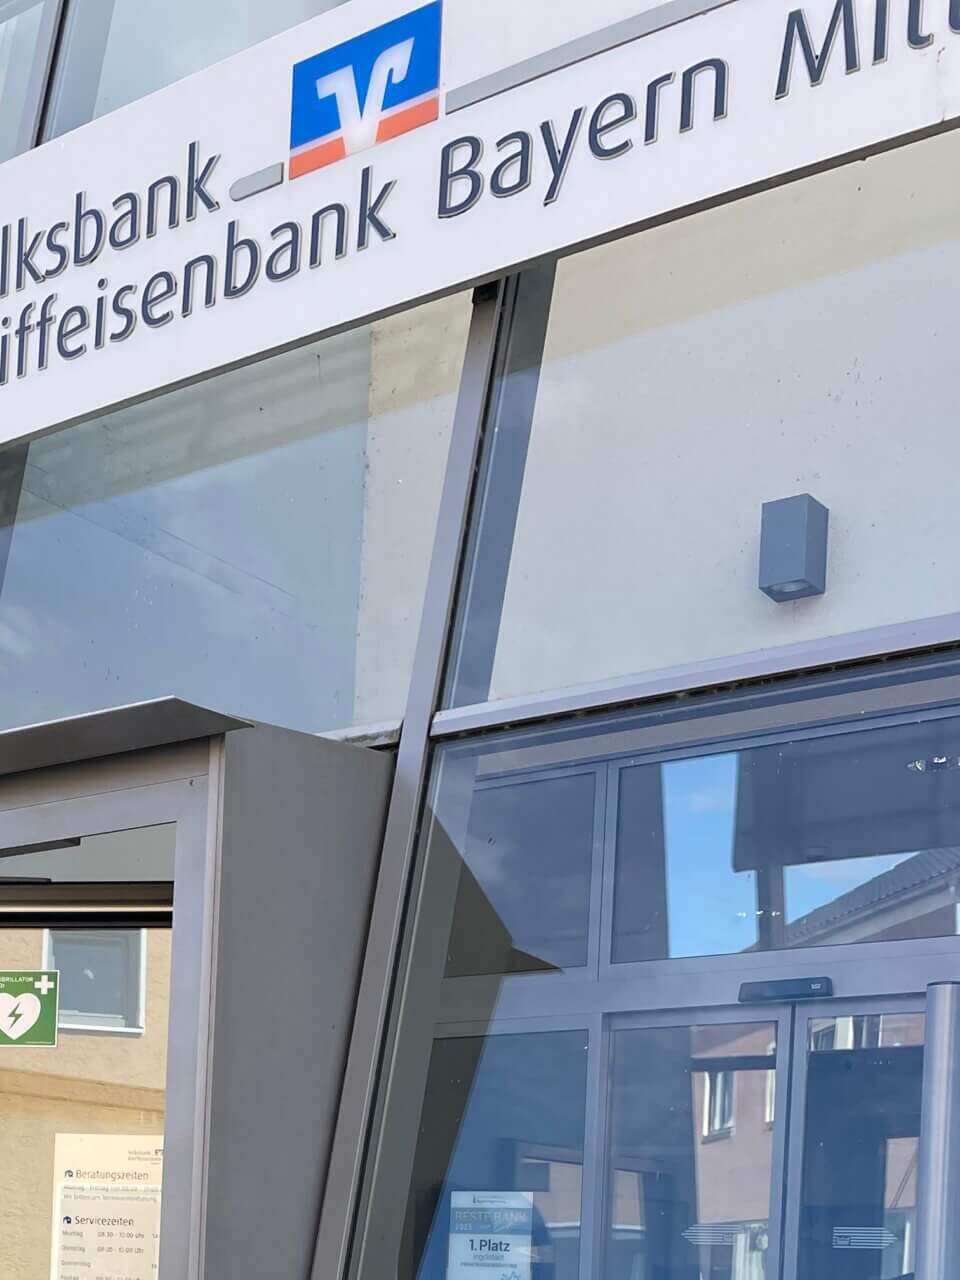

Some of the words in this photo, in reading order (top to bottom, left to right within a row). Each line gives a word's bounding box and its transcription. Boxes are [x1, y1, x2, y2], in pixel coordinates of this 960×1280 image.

[438, 58, 730, 219] Bayern
[75, 1169, 149, 1182] Beratungszeiten
[75, 1216, 135, 1226] Servicezeiten
[469, 1239, 477, 1251] 1.
[479, 1239, 511, 1252] Platz
